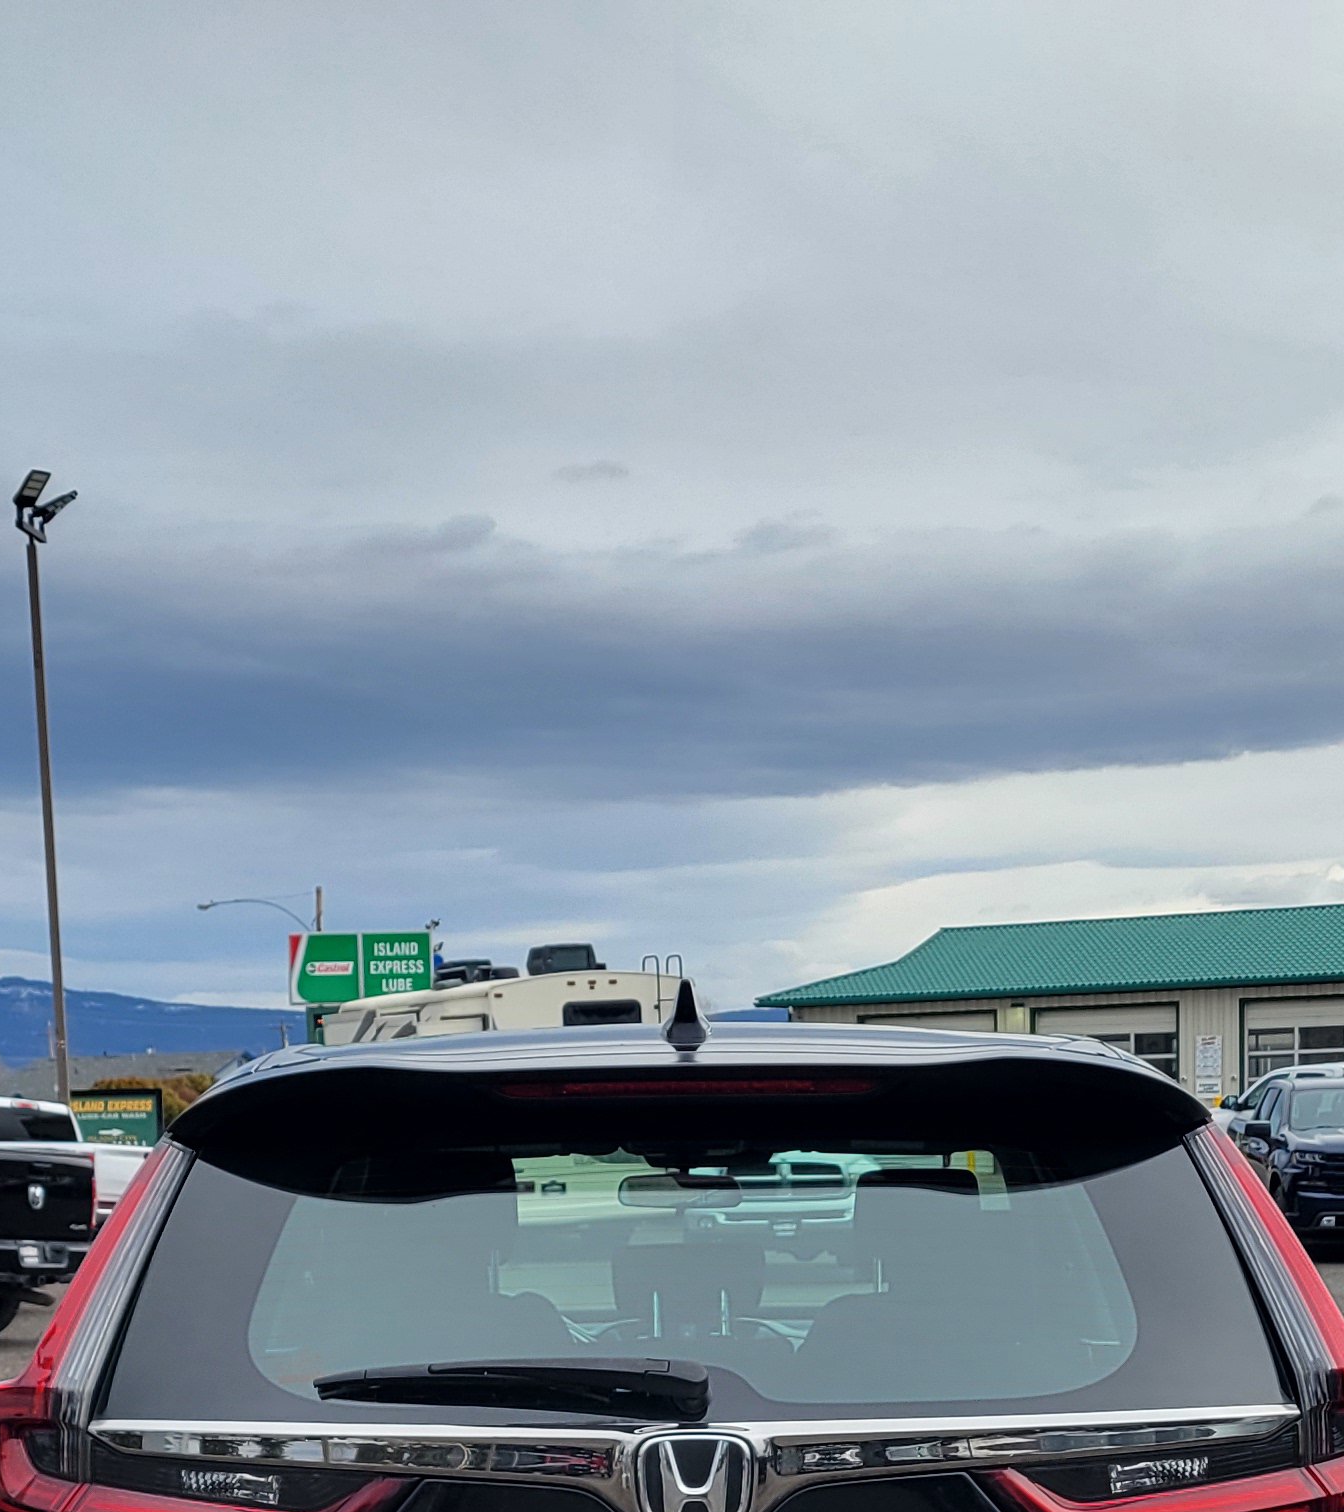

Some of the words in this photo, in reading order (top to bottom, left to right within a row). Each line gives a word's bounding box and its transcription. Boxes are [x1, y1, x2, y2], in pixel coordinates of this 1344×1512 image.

[373, 942, 419, 957] ISLAND
[316, 963, 350, 973] Castrol
[369, 960, 425, 975] EXPRESS
[381, 978, 413, 992] LUBE
[107, 1098, 153, 1112] EXPRESS
